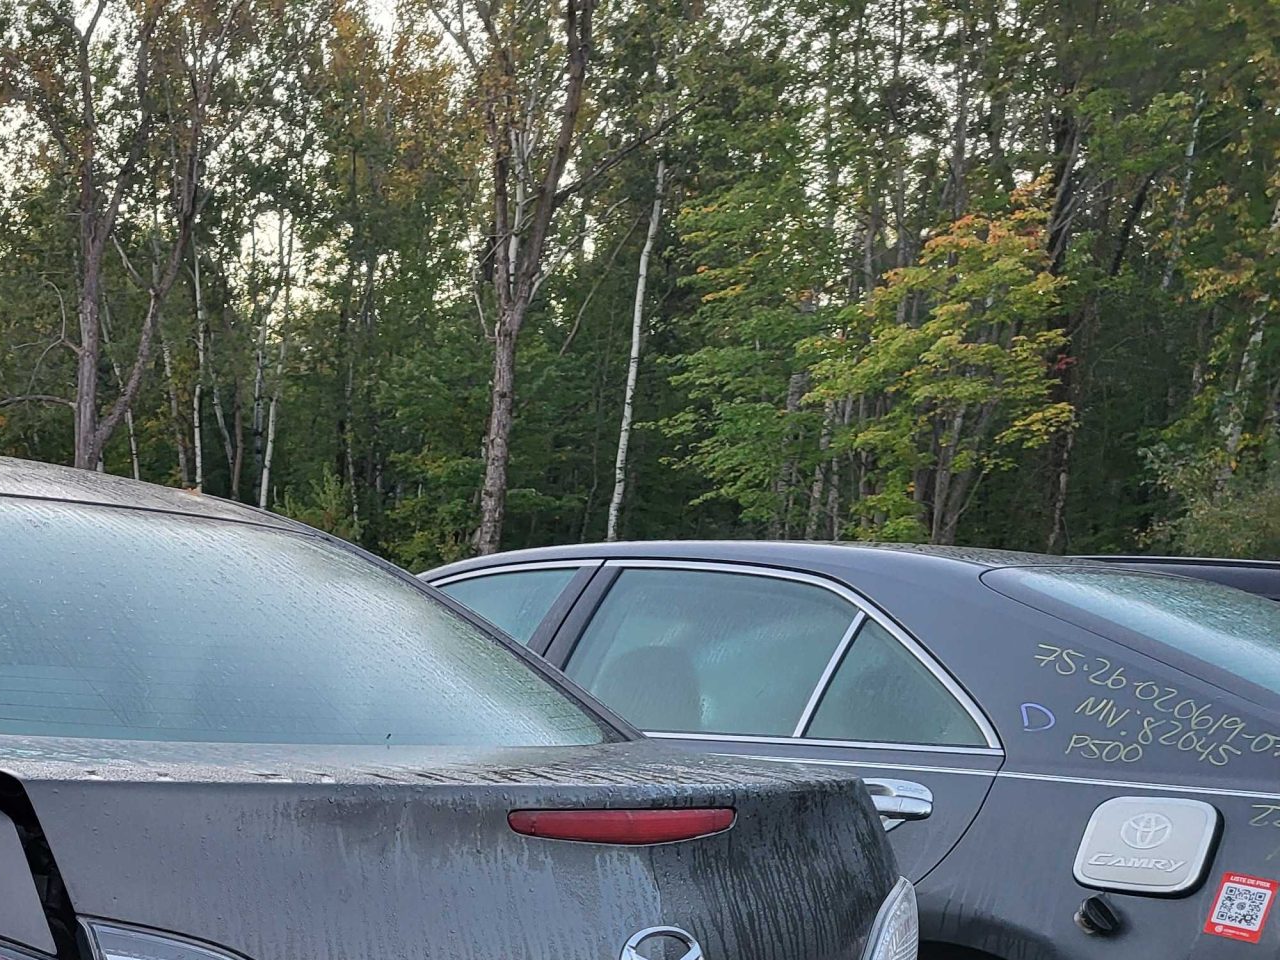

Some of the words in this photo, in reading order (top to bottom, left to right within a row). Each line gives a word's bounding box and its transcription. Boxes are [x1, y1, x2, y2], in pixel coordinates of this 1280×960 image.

[1020, 702, 1056, 732] D
[1137, 716, 1242, 766] 82045
[1087, 852, 1186, 873] CAMRY
